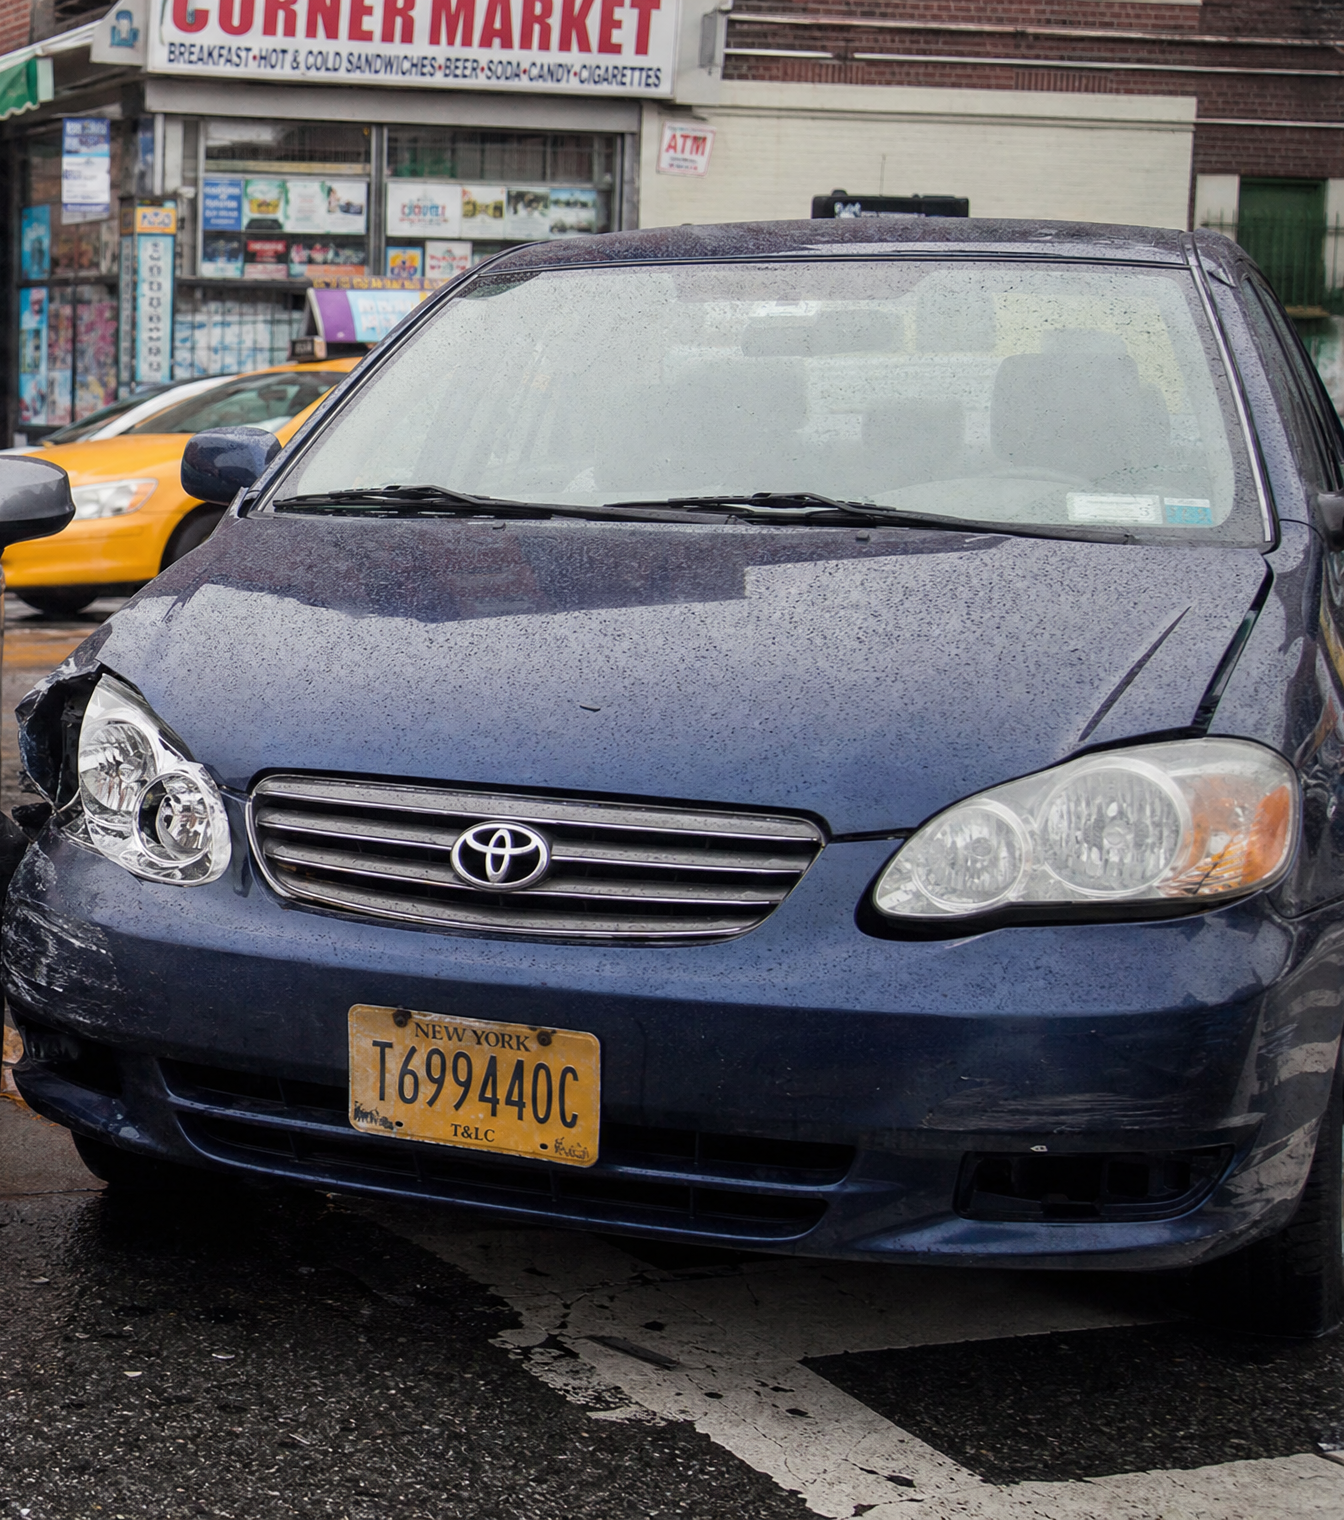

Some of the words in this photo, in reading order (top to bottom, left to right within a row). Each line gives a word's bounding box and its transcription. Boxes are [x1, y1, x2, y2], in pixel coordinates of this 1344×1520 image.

[171, 0, 414, 44] CORNER
[428, 0, 661, 56] MARKET
[167, 42, 252, 68] BREAKFAST
[257, 48, 289, 70] HOT
[291, 49, 301, 70] &
[305, 50, 342, 72] COLD
[345, 52, 437, 77] SANDWICHES
[443, 57, 480, 80] BEER
[485, 60, 522, 82] SODA
[528, 62, 574, 84] CANDY
[578, 64, 662, 88] CIGARETTES
[664, 133, 708, 157] ATM
[414, 1022, 466, 1043] NEW
[470, 1029, 531, 1053] YORK
[371, 1039, 580, 1130] T699440C
[450, 1122, 496, 1144] T&LC
